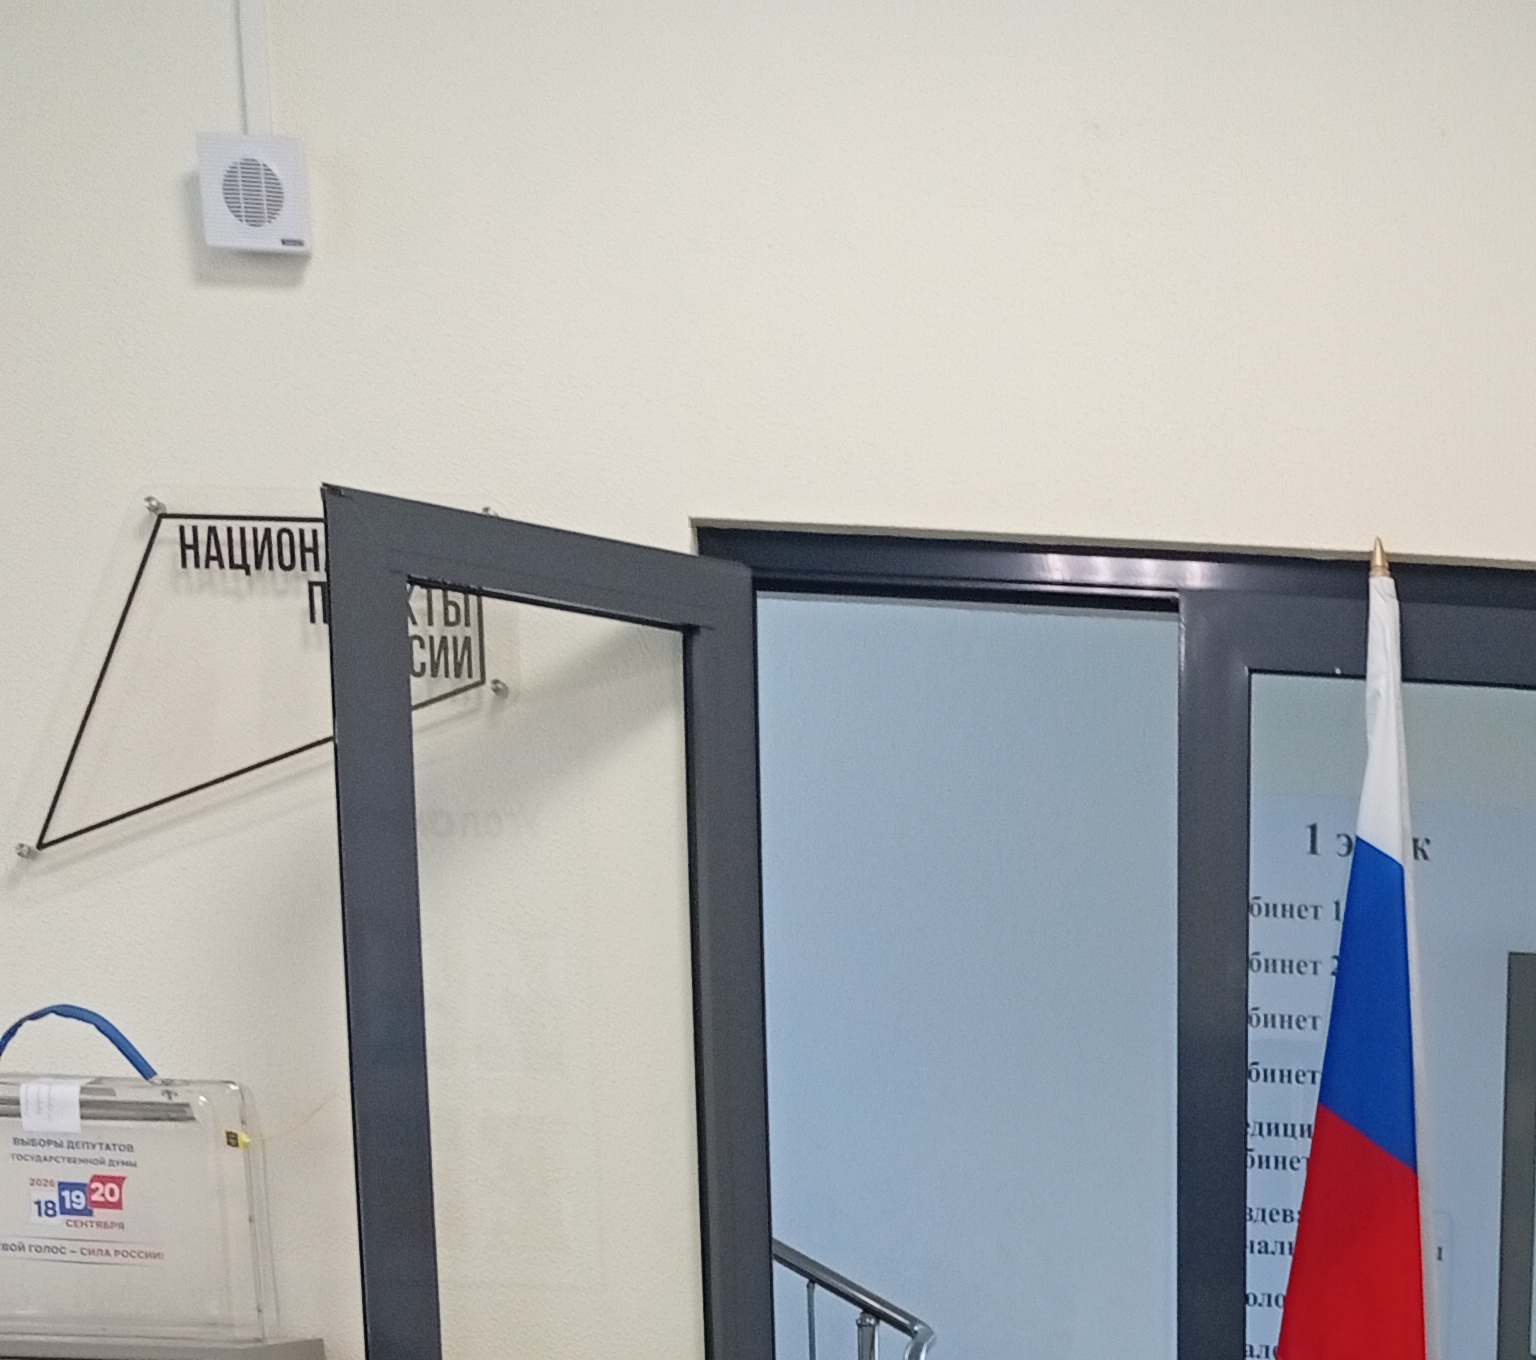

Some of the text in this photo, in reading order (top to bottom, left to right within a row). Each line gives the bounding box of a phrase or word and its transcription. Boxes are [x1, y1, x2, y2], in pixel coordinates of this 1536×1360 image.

[178, 524, 327, 575] НАЦИОН
[410, 634, 473, 679] СИИ
[1306, 822, 1320, 856] 1
[1249, 896, 1323, 921] бинет
[1248, 951, 1323, 975] бинет
[1248, 1007, 1321, 1031] бинет
[1247, 1061, 1322, 1086] бинет
[12, 1136, 135, 1153] ВЫБОРЫ ДЕПУТАТОВ
[33, 1182, 120, 1218] 18 19 20
[65, 1218, 126, 1231] СЕНТЯБРЯ
[28, 1244, 67, 1256] ГОЛОС
[79, 1246, 111, 1258] СИЛА
